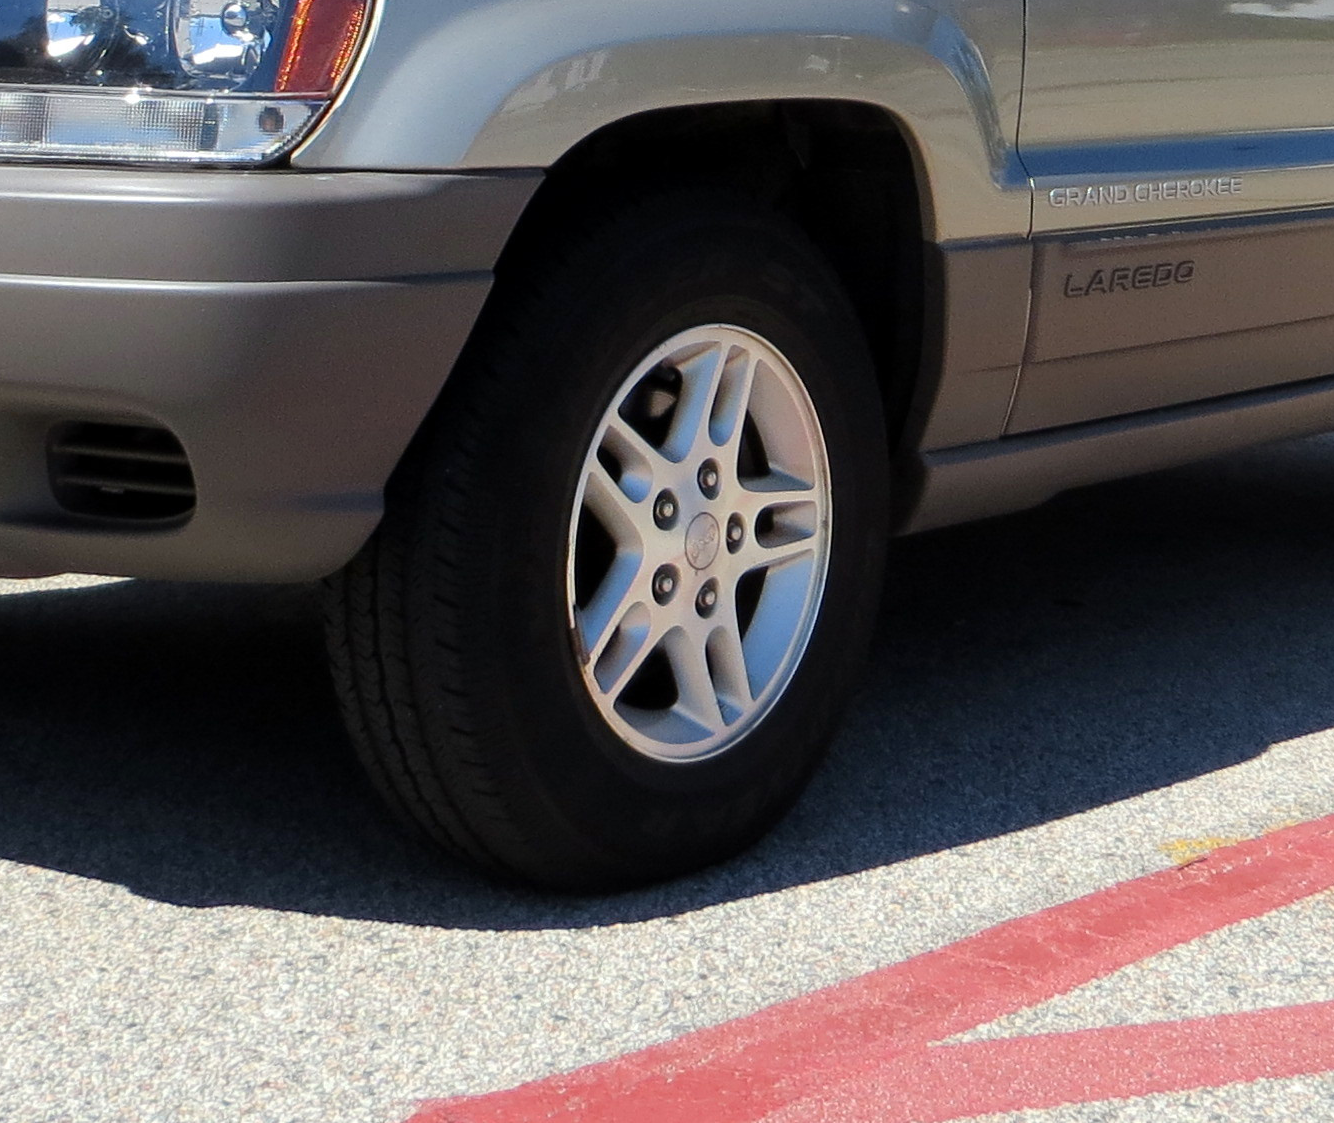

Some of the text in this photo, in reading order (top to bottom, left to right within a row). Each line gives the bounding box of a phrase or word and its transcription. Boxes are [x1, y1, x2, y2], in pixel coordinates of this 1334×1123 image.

[1049, 176, 1244, 208] GRAND CHEROKEE
[1064, 260, 1195, 298] LAREDO
